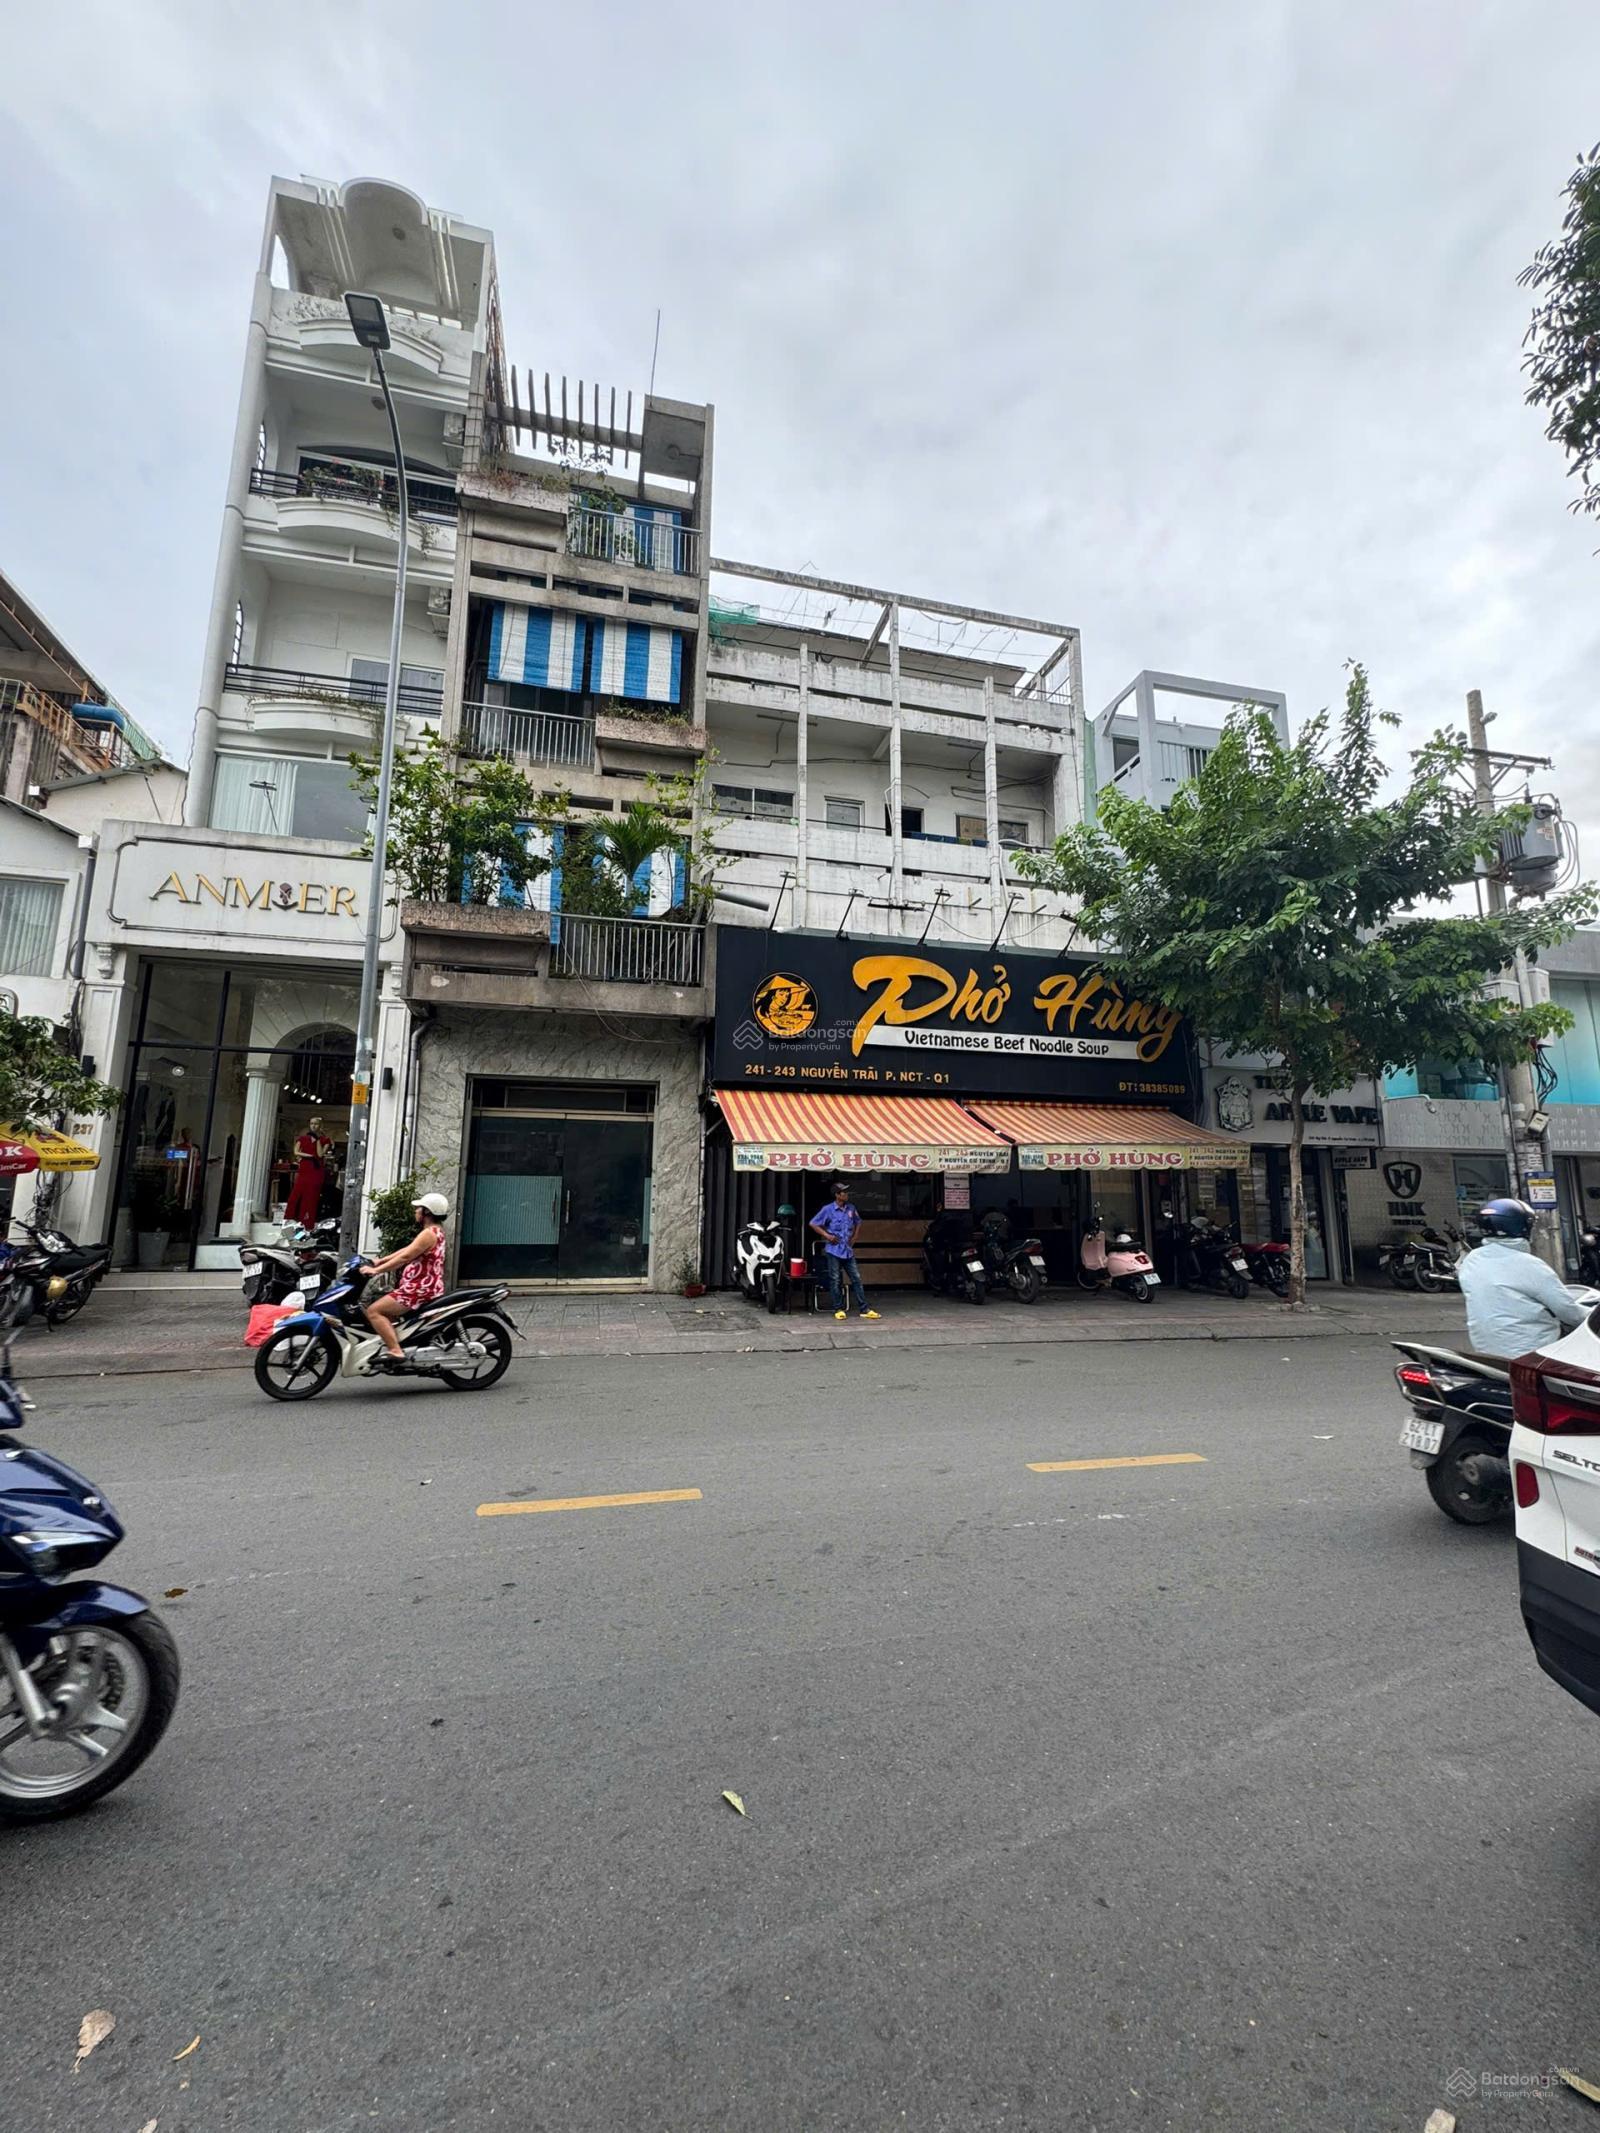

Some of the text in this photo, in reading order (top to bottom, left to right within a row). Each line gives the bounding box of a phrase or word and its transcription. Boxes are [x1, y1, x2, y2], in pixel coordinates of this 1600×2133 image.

[852, 955, 1182, 1062] Phở Hùng
[905, 1030, 1109, 1056] Vietnamese Beef Noodle Soup
[801, 1062, 849, 1079] NGUYỄN
[852, 1066, 878, 1081] TRÃI
[41, 1145, 88, 1155] maxim
[767, 1147, 834, 1167] PHỞ
[843, 1150, 931, 1168] HÙNG
[1047, 1147, 1101, 1166] PHỞ
[1108, 1149, 1183, 1166] HÙNG
